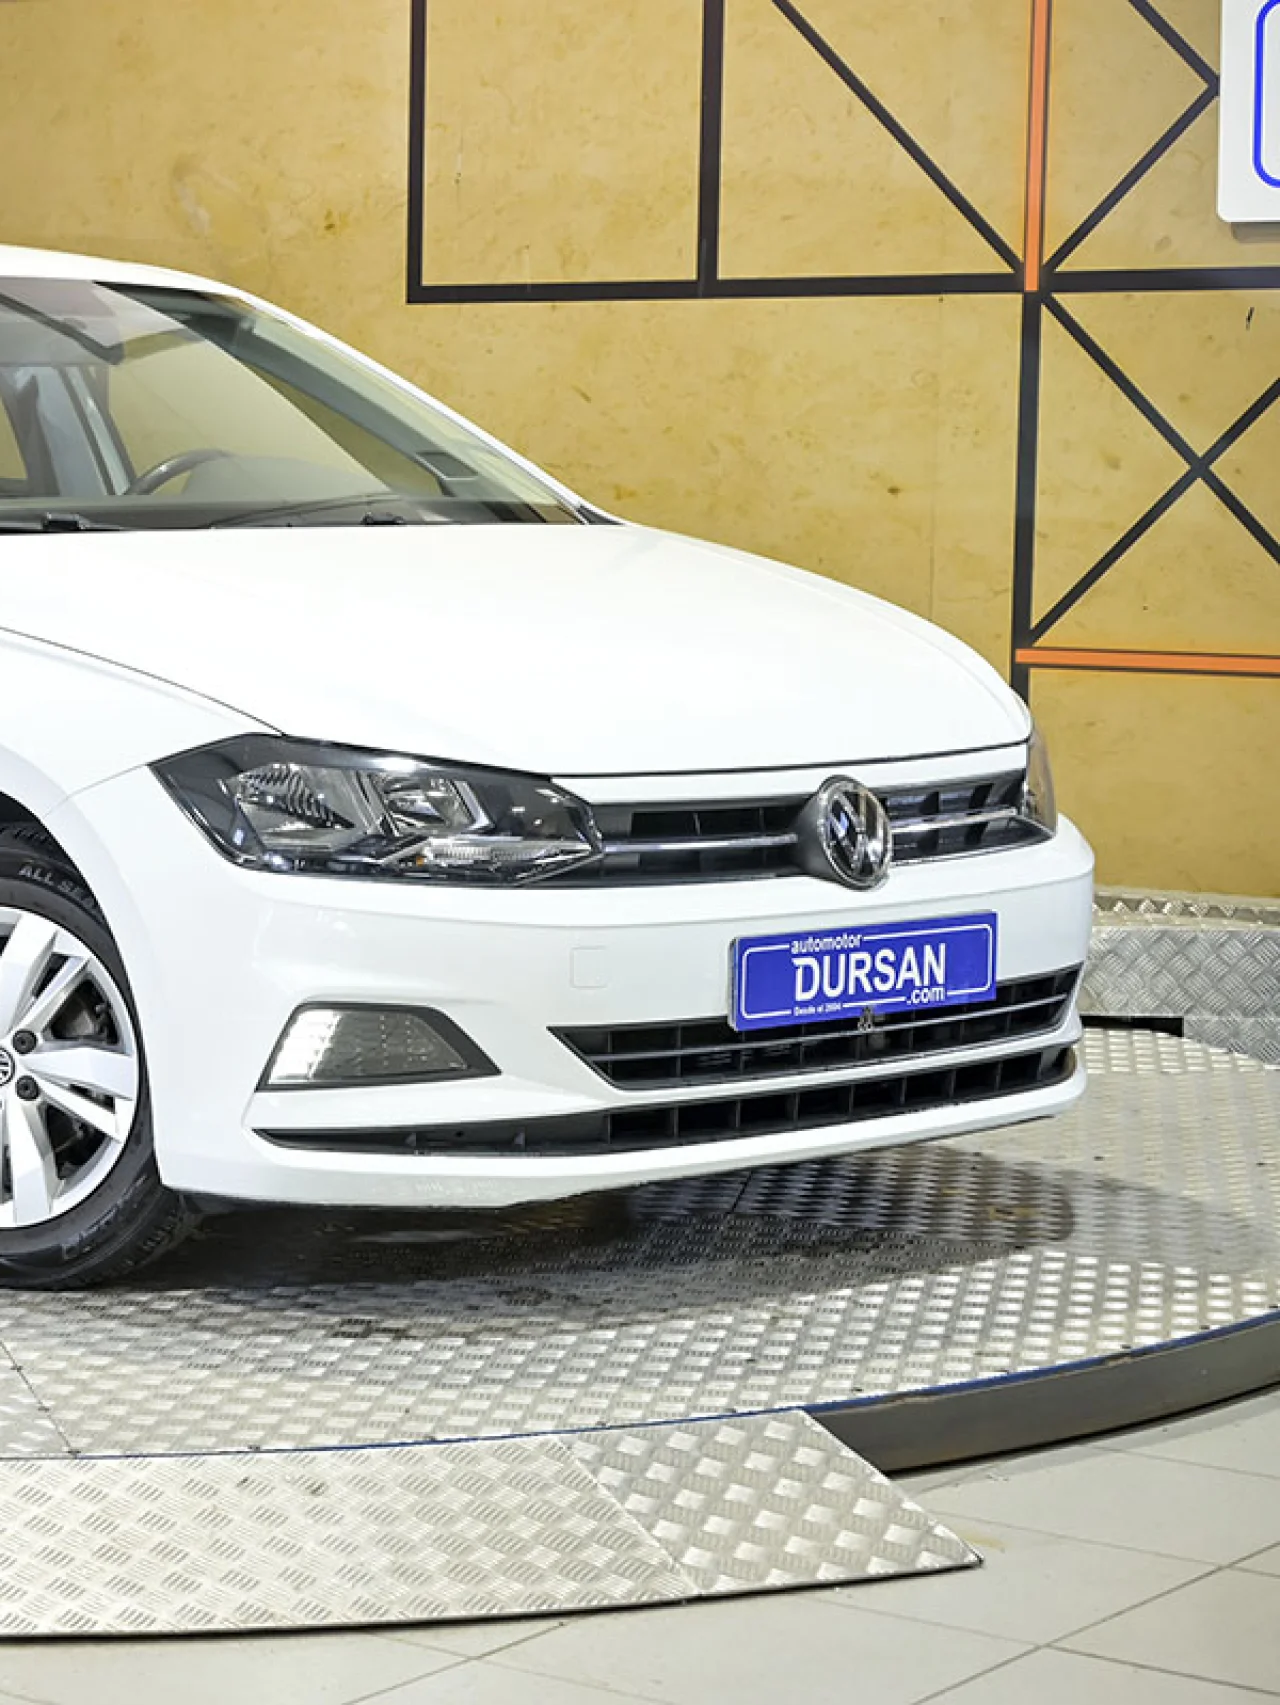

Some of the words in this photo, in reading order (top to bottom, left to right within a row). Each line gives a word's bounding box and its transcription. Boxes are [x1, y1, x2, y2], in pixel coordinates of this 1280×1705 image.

[791, 932, 862, 954] automotor
[791, 943, 946, 1002] DURSAN
[906, 986, 946, 1005] .com
